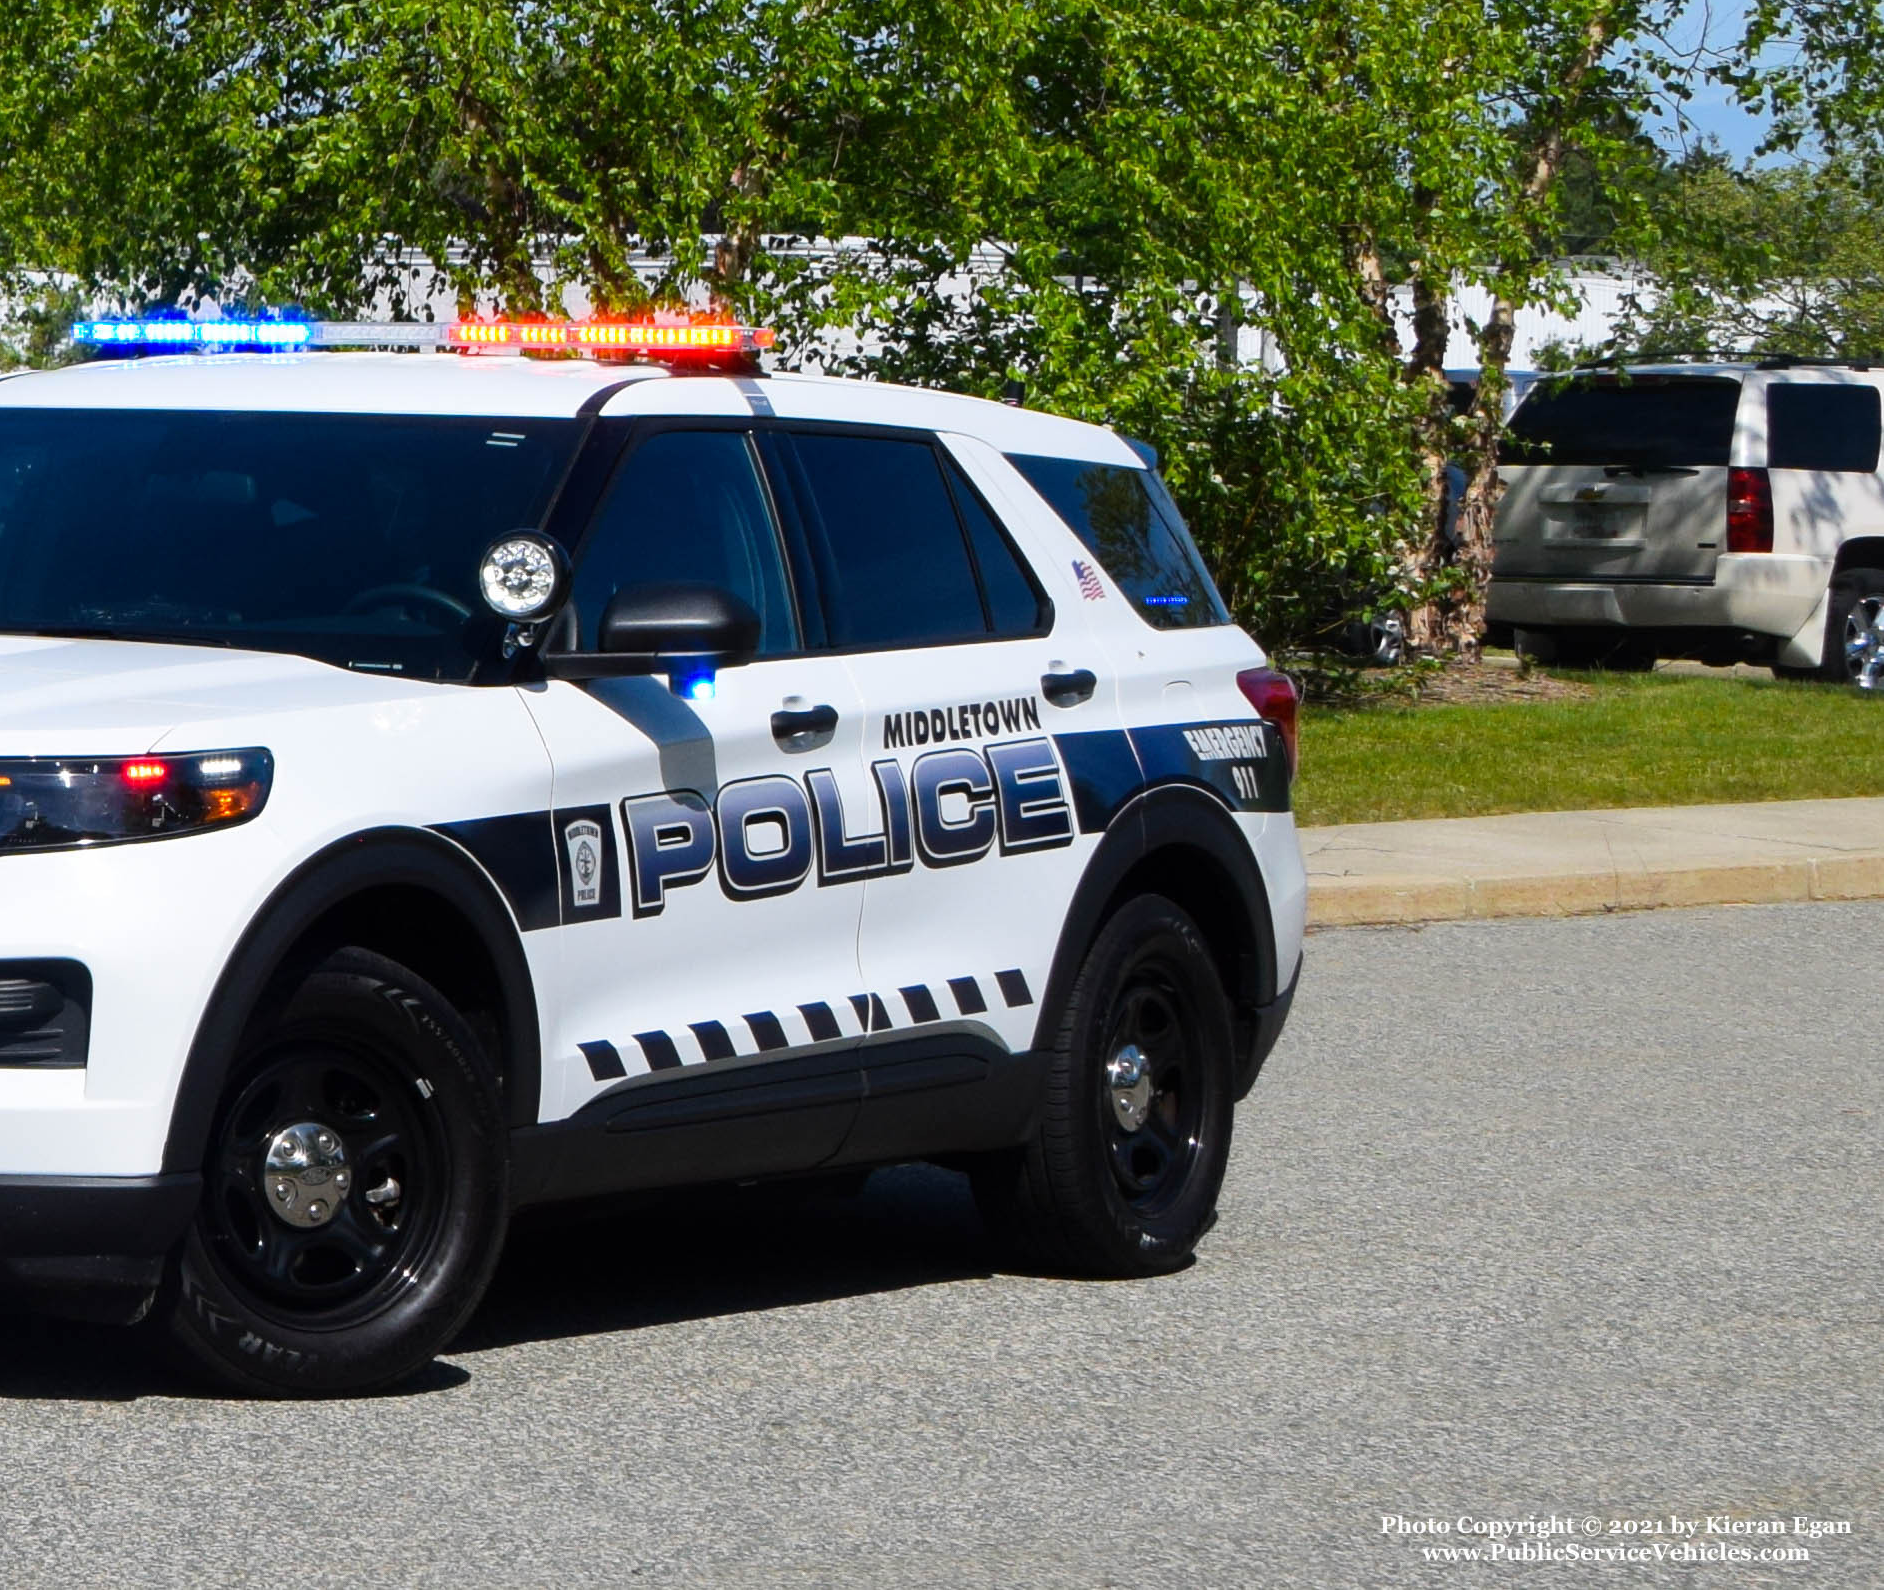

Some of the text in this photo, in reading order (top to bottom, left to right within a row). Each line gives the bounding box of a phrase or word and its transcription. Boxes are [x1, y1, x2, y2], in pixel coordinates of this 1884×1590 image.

[883, 696, 1042, 750] MIDDLETOWN
[1182, 725, 1268, 761] EMERGENCY
[1231, 766, 1259, 800] 911
[619, 735, 1075, 920] POLICE
